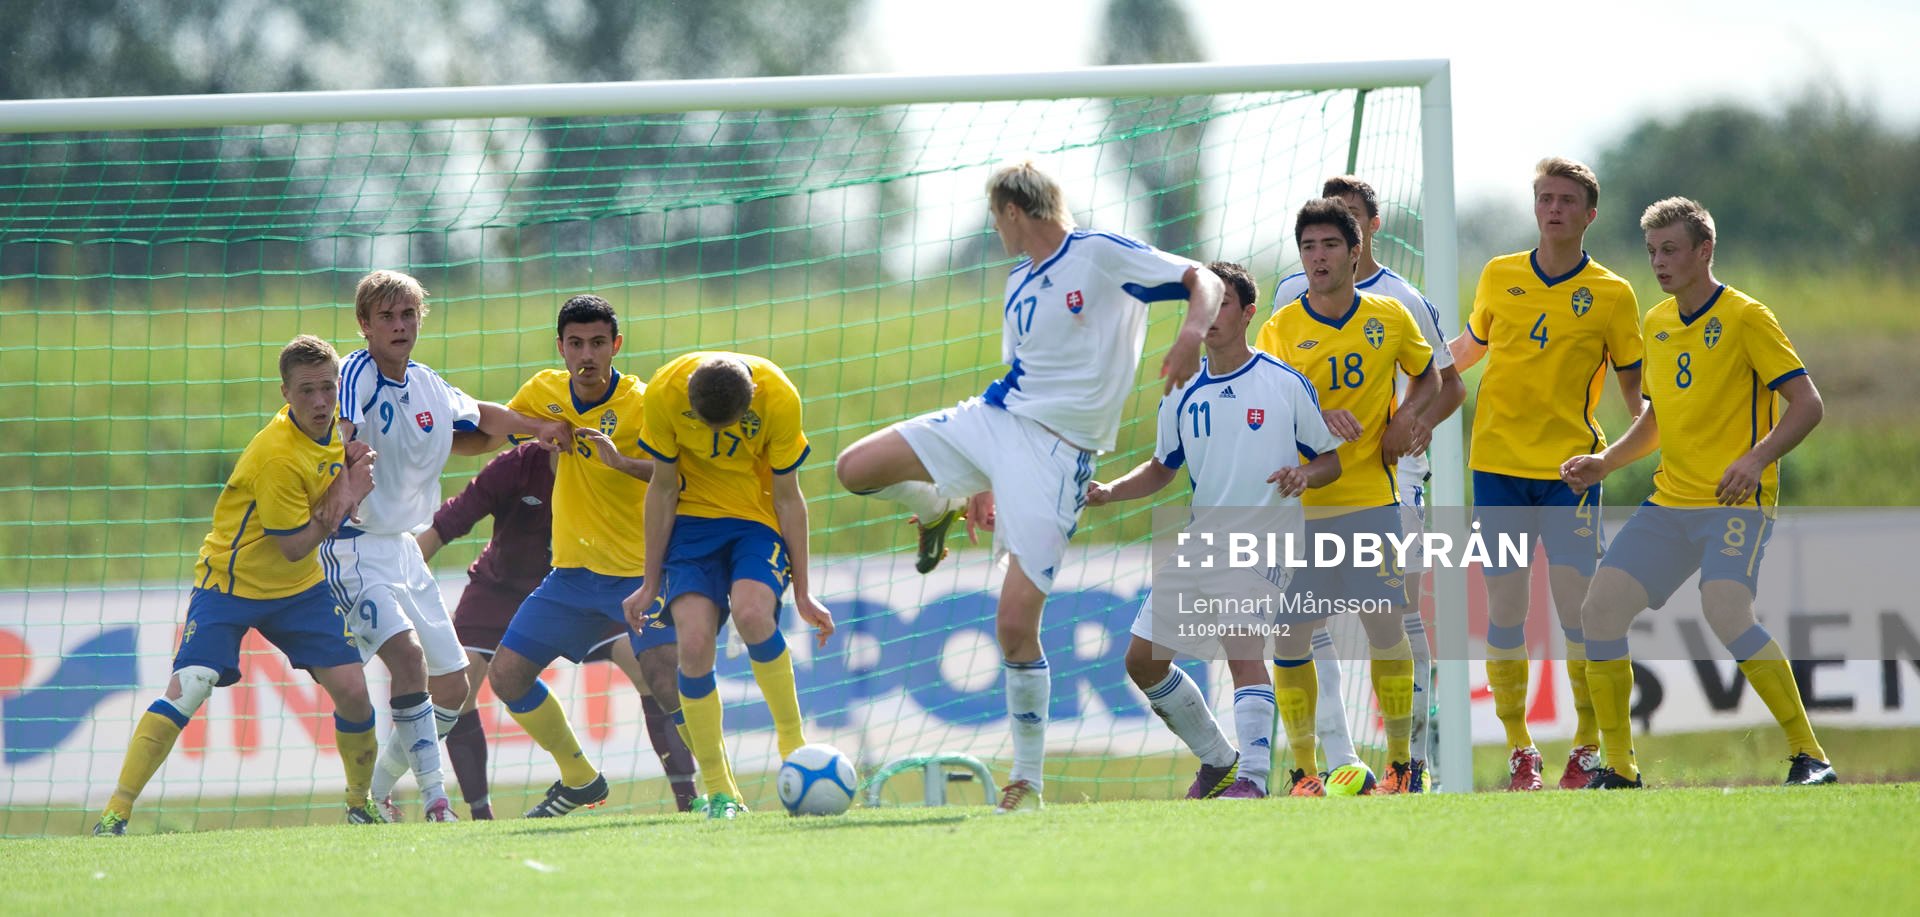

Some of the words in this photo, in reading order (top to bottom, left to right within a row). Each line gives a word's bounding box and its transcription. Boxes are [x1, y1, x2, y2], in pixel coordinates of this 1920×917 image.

[1013, 295, 1037, 336] 17
[1529, 312, 1549, 349] 4
[1328, 352, 1364, 390] 18
[1675, 352, 1692, 389] 8
[379, 400, 394, 435] 9
[1188, 400, 1211, 438] 11
[709, 430, 741, 459] 17
[1575, 489, 1592, 527] 4
[1723, 516, 1746, 547] 8
[359, 599, 378, 629] 9
